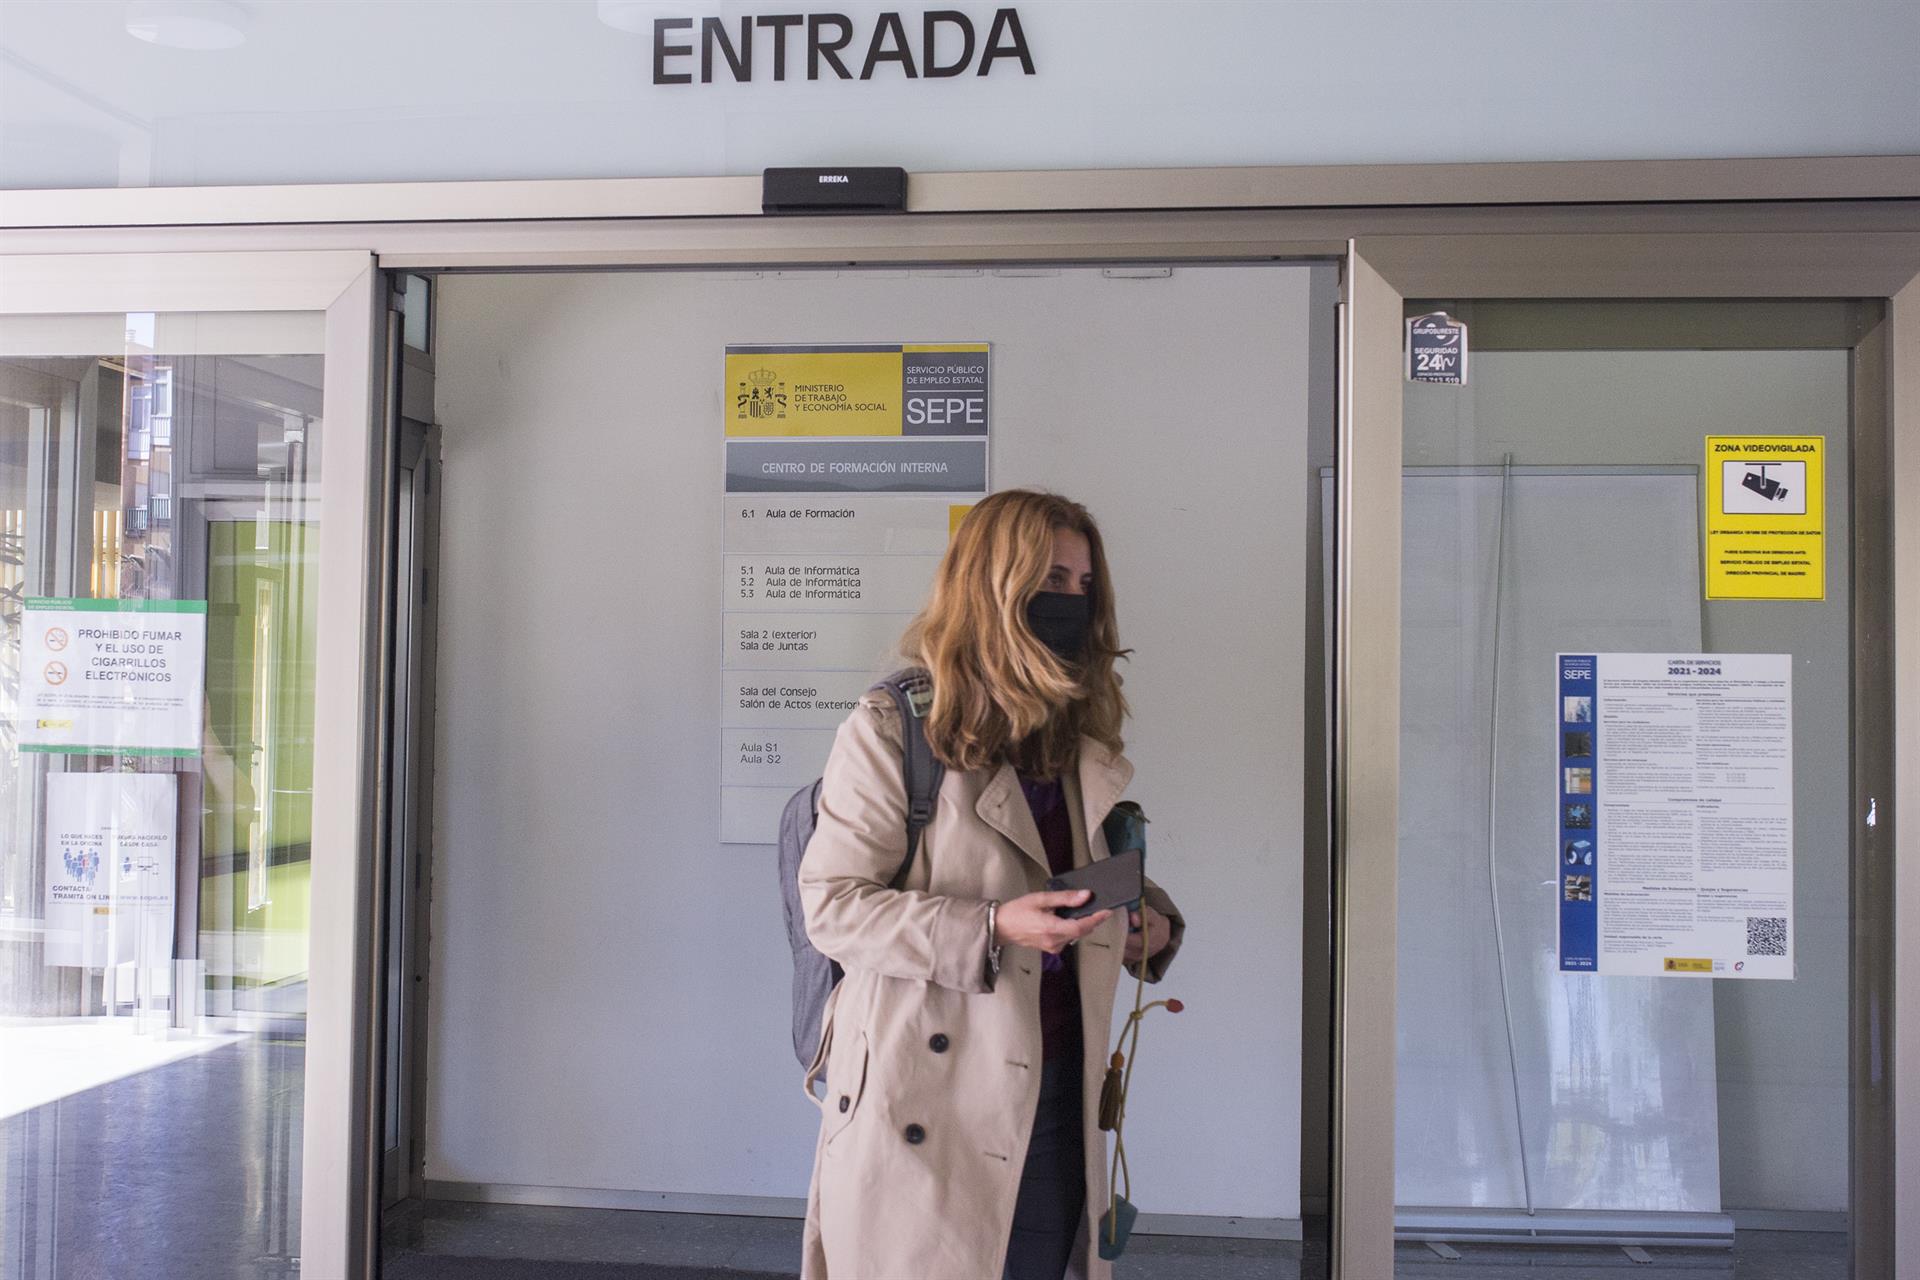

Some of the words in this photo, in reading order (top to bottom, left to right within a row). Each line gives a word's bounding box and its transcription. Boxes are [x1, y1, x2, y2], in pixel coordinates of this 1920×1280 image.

[653, 8, 1037, 85] ENTRADA
[819, 175, 849, 183] ERREKA
[907, 366, 945, 374] SERVICIO
[947, 364, 984, 374] PÚBLICO
[952, 376, 984, 384] ESTATAL
[794, 384, 845, 392] MINISTERIO
[794, 393, 806, 401] DE
[806, 394, 847, 403] TRABAJO
[794, 403, 801, 411] Y
[803, 402, 853, 411] ECONOMÍA
[855, 403, 887, 411] SOCIAL
[906, 397, 984, 425] SEPE
[1714, 444, 1741, 452] ZONA
[1743, 444, 1816, 453] VIDEOVIGILADA
[762, 463, 806, 473] CENTRO
[811, 463, 825, 473] DE
[829, 461, 896, 473] FORMACIÓN
[901, 463, 948, 473] INTERNA
[741, 509, 755, 518] 6.1
[766, 509, 787, 518] Aula
[789, 509, 801, 518] de
[805, 509, 855, 518] Formación
[740, 566, 754, 575] 5.1
[765, 566, 785, 575] Aula
[788, 566, 801, 575] de
[804, 566, 860, 575] Informática
[740, 578, 754, 587] 5.2
[766, 578, 786, 587] Aula
[789, 578, 802, 587] de
[805, 577, 861, 587] Informática
[740, 589, 754, 598] 5.3
[766, 589, 786, 598] Aula
[789, 589, 802, 598] de
[805, 589, 861, 599] Informática
[78, 629, 139, 639] PROHIBIDO
[142, 631, 182, 640] FUMAR
[740, 630, 759, 639] Sala
[762, 630, 768, 639] 2
[772, 630, 817, 640] (exterior)
[95, 643, 103, 653] Y
[105, 643, 118, 653] EL
[122, 644, 145, 653] USO
[149, 645, 164, 654] DE
[740, 641, 759, 650] Sala
[762, 641, 774, 650] de
[777, 641, 808, 651] Juntas
[91, 657, 166, 668] CIGARRILLOS
[1563, 669, 1592, 680] SEPE
[1668, 667, 1691, 675] 2021
[1698, 667, 1721, 675] 2024
[740, 687, 758, 696] Sala
[761, 687, 777, 696] del
[780, 687, 817, 698] Consejo
[740, 699, 765, 709] Salón
[768, 699, 781, 709] de
[784, 699, 811, 709] Actos
[740, 743, 762, 752] Aula
[765, 743, 778, 752] S1
[740, 755, 762, 764] Aula
[766, 755, 781, 764] S2
